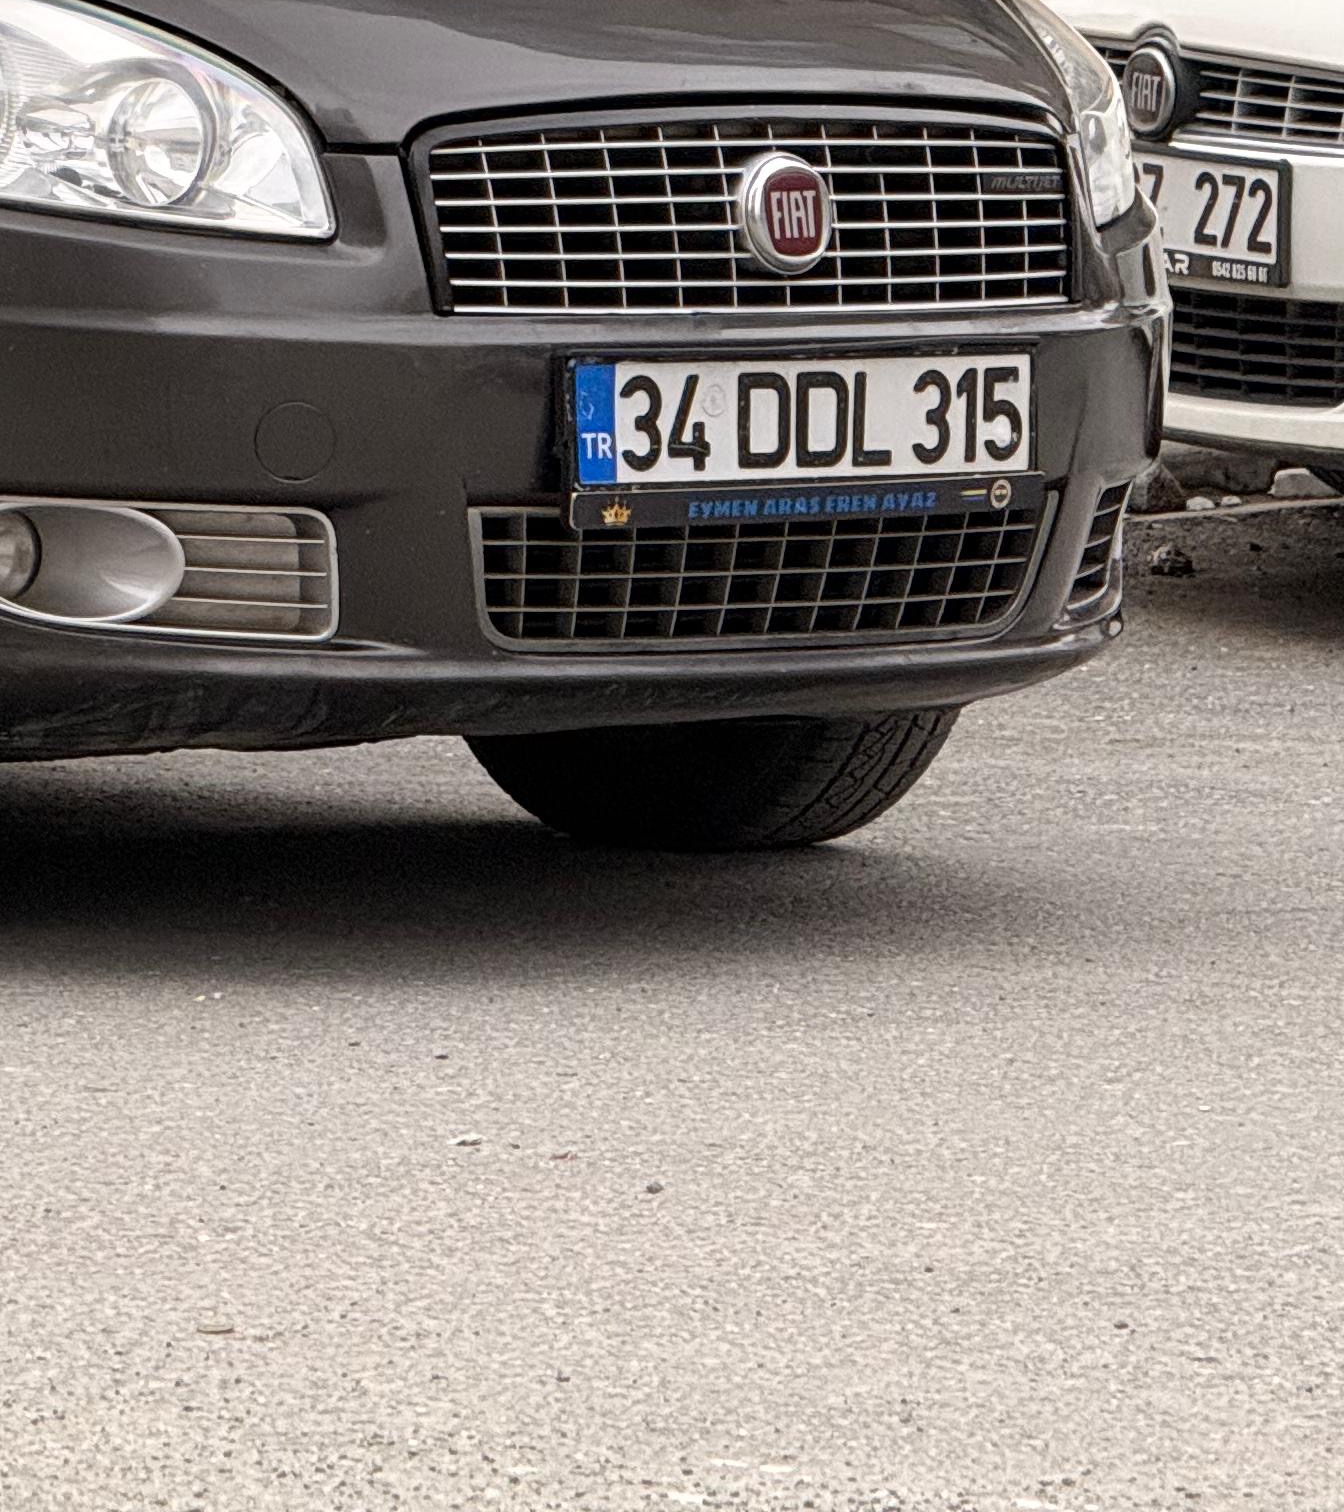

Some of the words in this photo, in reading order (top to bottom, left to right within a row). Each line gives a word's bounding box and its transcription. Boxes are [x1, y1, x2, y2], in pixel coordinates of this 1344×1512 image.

[1132, 72, 1161, 112] FIAT
[770, 190, 816, 240] FIAT
[1193, 171, 1273, 255] 272
[619, 374, 711, 472] 34
[737, 371, 892, 469] DDL
[911, 366, 1022, 464] 315
[581, 432, 612, 460] TR
[688, 499, 759, 520] EYMEN
[763, 496, 820, 516] ARAS
[825, 493, 877, 513] EREN
